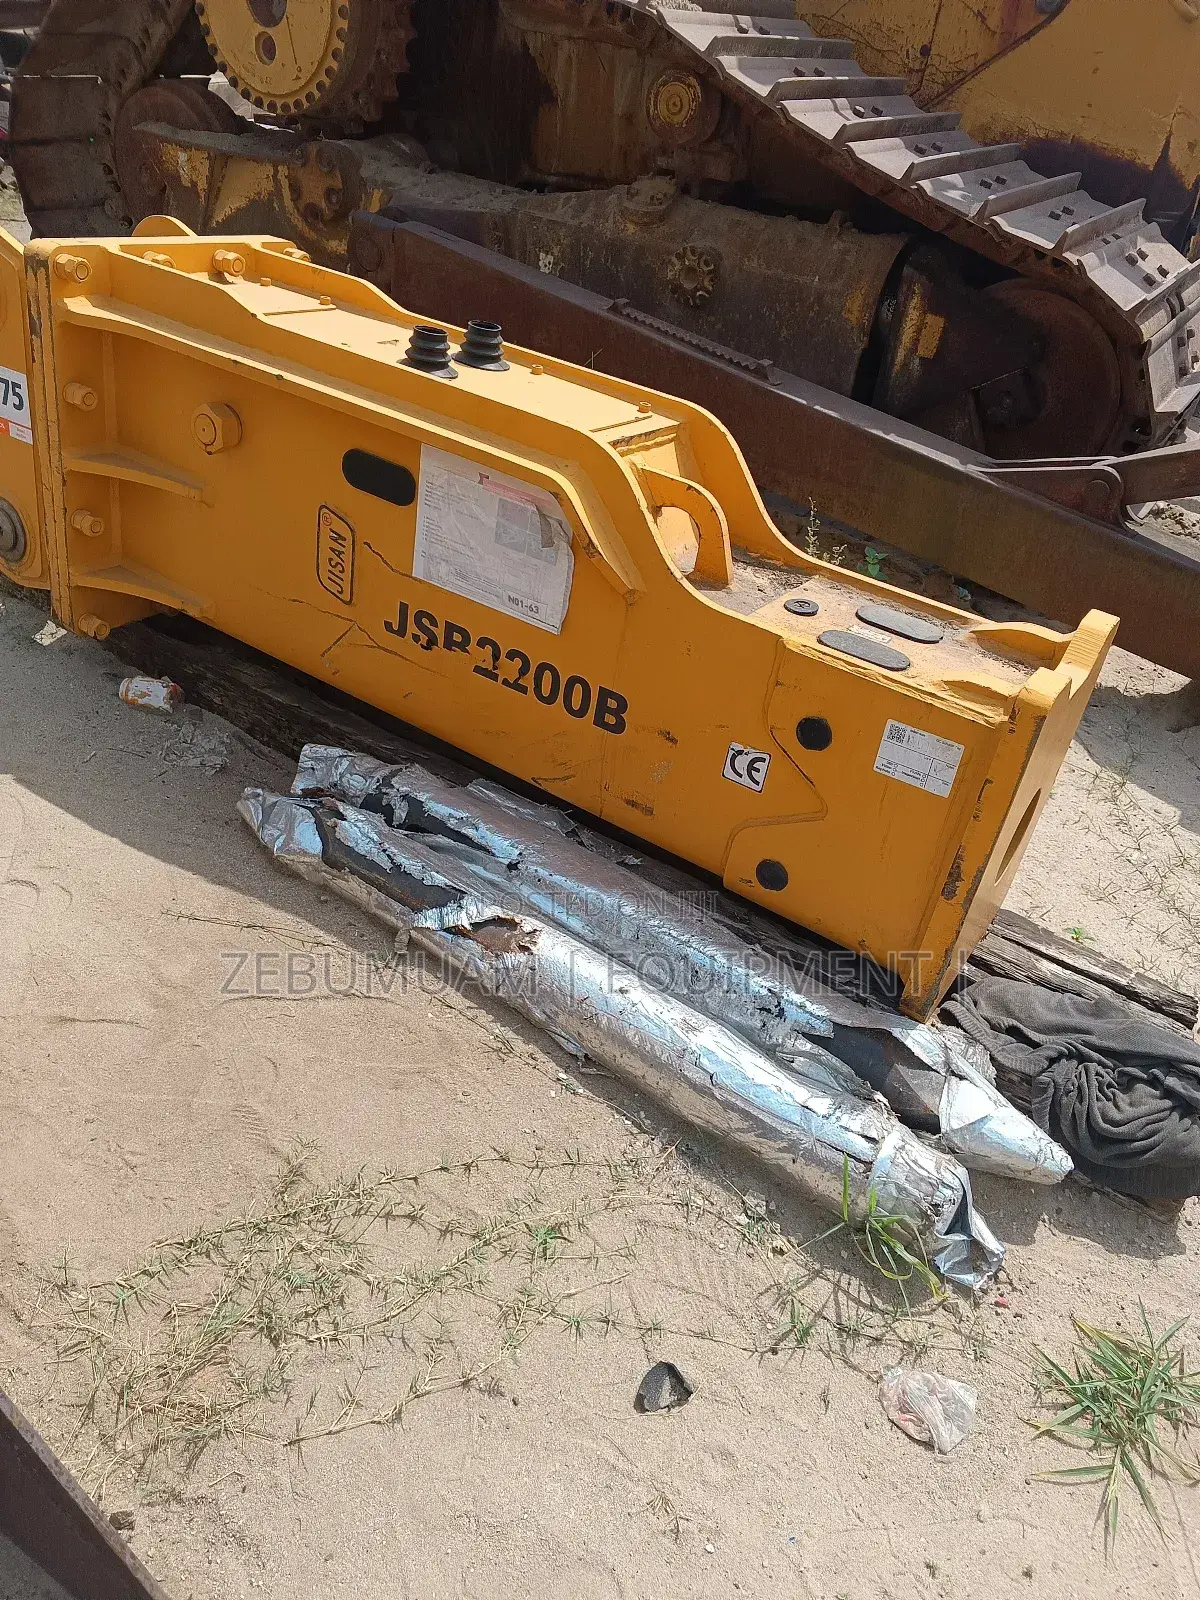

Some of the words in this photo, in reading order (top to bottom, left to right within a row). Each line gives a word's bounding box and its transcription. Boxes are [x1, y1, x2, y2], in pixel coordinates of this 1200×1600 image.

[327, 527, 347, 595] JISAN
[383, 600, 629, 735] JSB2200B
[730, 747, 767, 787] CE
